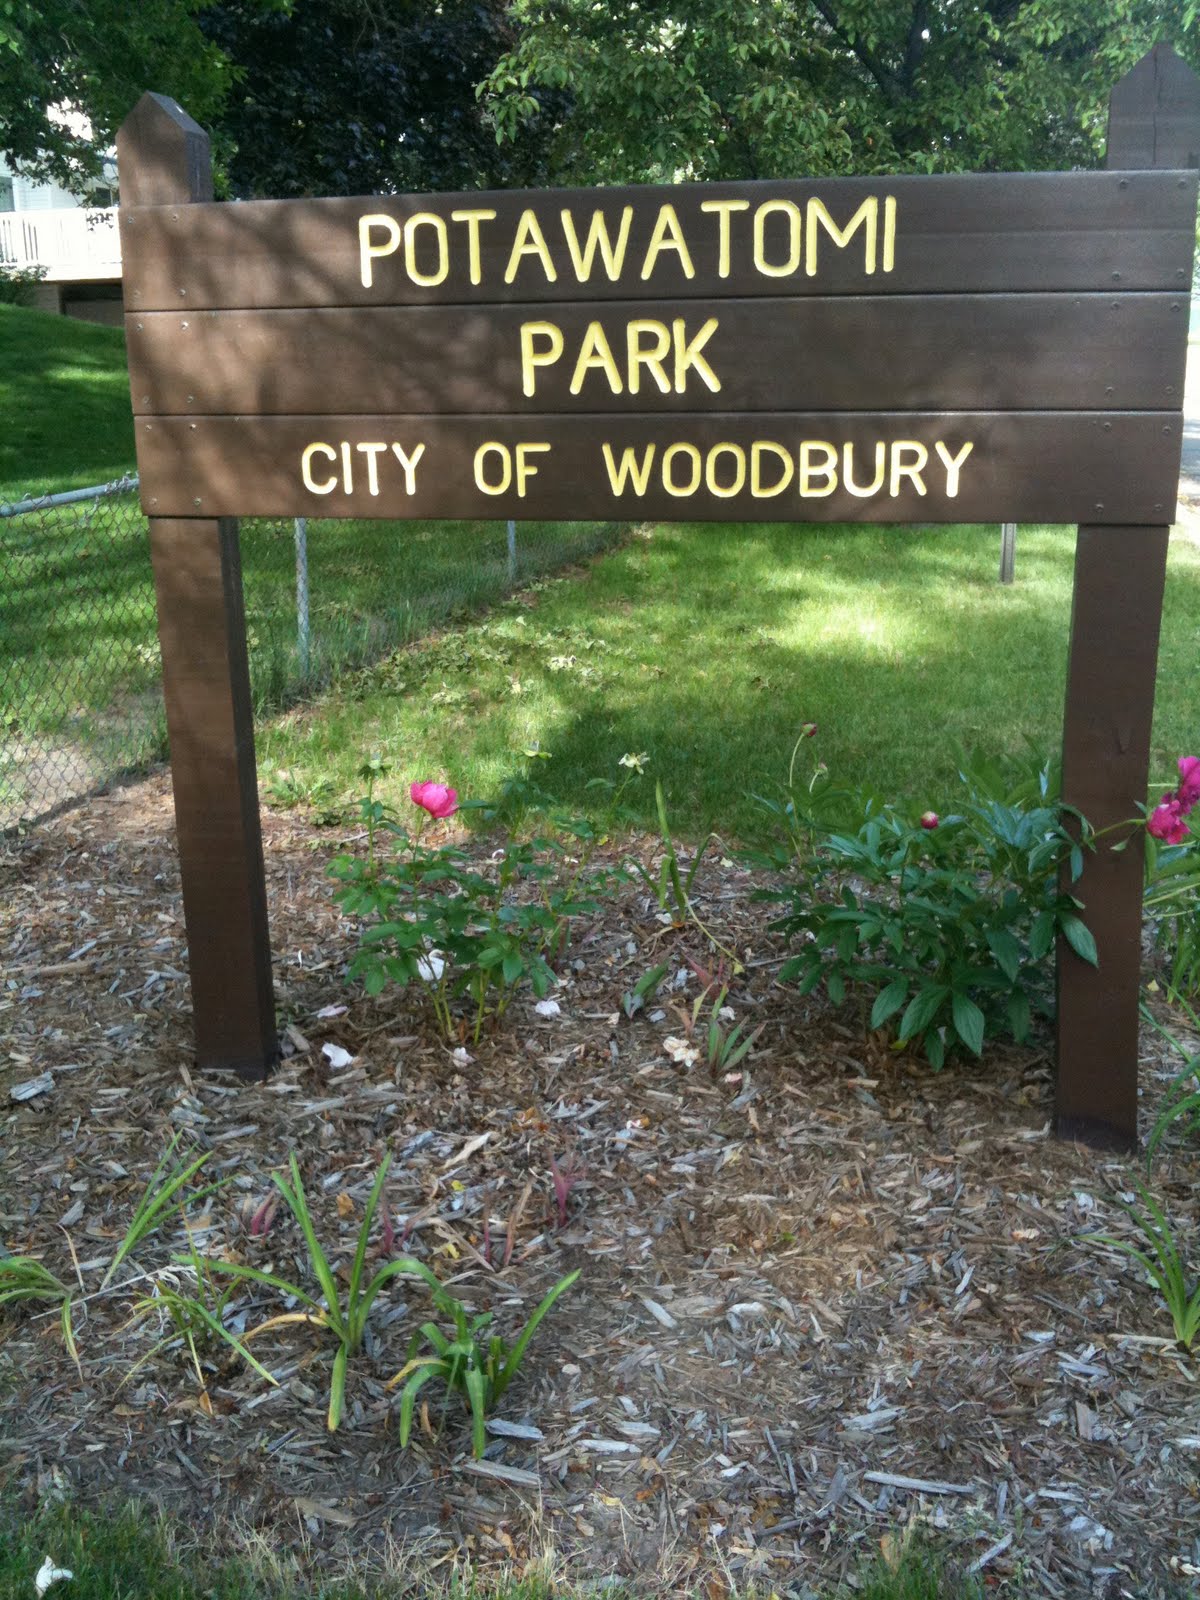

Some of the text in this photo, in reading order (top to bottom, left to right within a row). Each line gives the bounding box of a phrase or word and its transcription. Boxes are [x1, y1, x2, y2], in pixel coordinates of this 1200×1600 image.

[358, 195, 897, 289] POTAWATOMI
[519, 318, 722, 398] PARK
[301, 440, 975, 498] CITY OF WOODBURY
